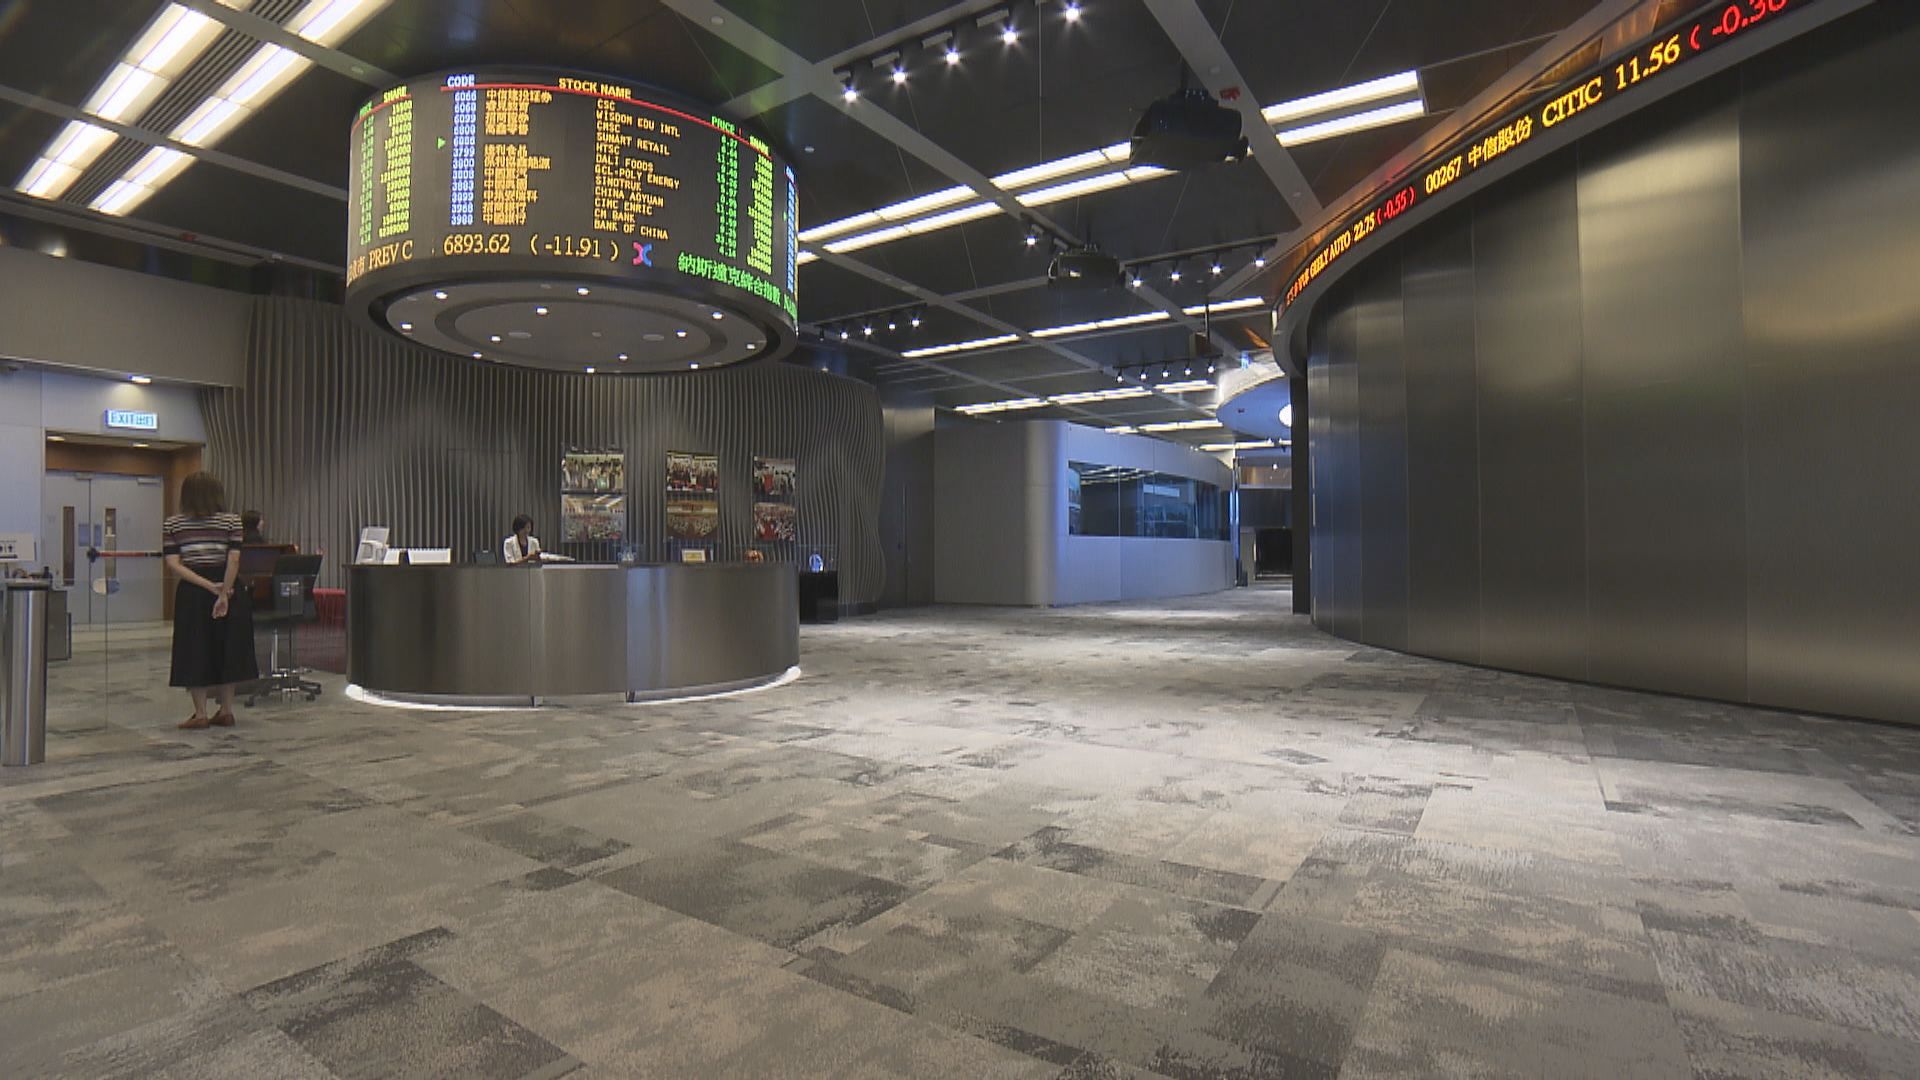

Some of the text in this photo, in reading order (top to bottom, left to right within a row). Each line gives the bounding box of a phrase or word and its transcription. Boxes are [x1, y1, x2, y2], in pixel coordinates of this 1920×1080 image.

[447, 75, 476, 88] CODE
[558, 78, 632, 99] STOCK NAME
[597, 98, 616, 111] CSC
[637, 117, 655, 131] EDU
[660, 123, 681, 137] INTL
[595, 142, 621, 155] HTSC
[637, 138, 670, 156] RETAIL
[1329, 230, 1351, 261] AUTO
[1353, 212, 1375, 242] 22.75
[1425, 156, 1462, 194] 00267
[1467, 115, 1533, 168] 中信股份
[1541, 76, 1603, 128] CITIC
[1615, 34, 1681, 90] 11.56
[595, 153, 654, 173] DALI FOODS
[594, 186, 625, 199] CHINA
[594, 198, 619, 210] CIMC
[594, 208, 636, 223] CM BANK
[593, 220, 669, 240] BANK OF CHINA
[443, 232, 511, 257] 6893.62
[368, 241, 399, 270] PREV
[110, 413, 135, 425] EXIT
